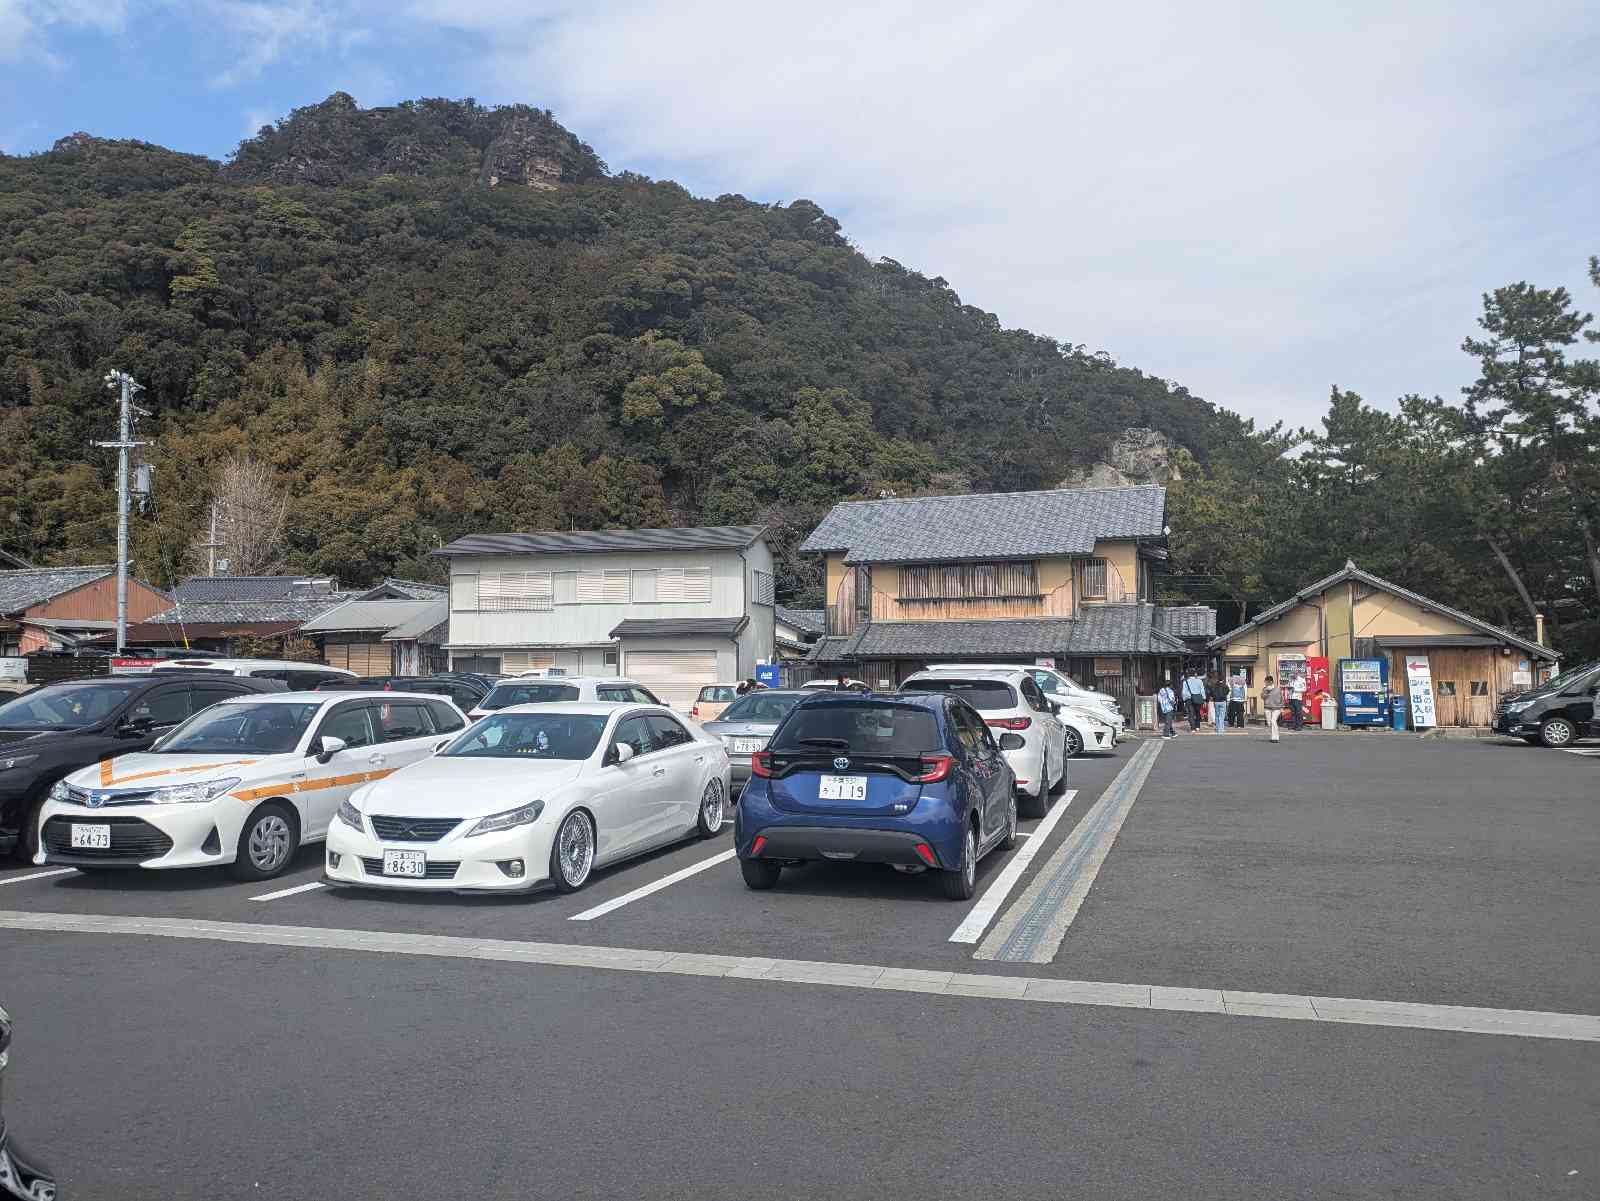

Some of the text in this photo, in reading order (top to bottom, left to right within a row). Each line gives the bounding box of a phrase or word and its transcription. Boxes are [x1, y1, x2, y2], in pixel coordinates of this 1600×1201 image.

[1412, 694, 1425, 724] 出入口
[80, 833, 108, 846] 64-73
[393, 860, 423, 874] 86-30
